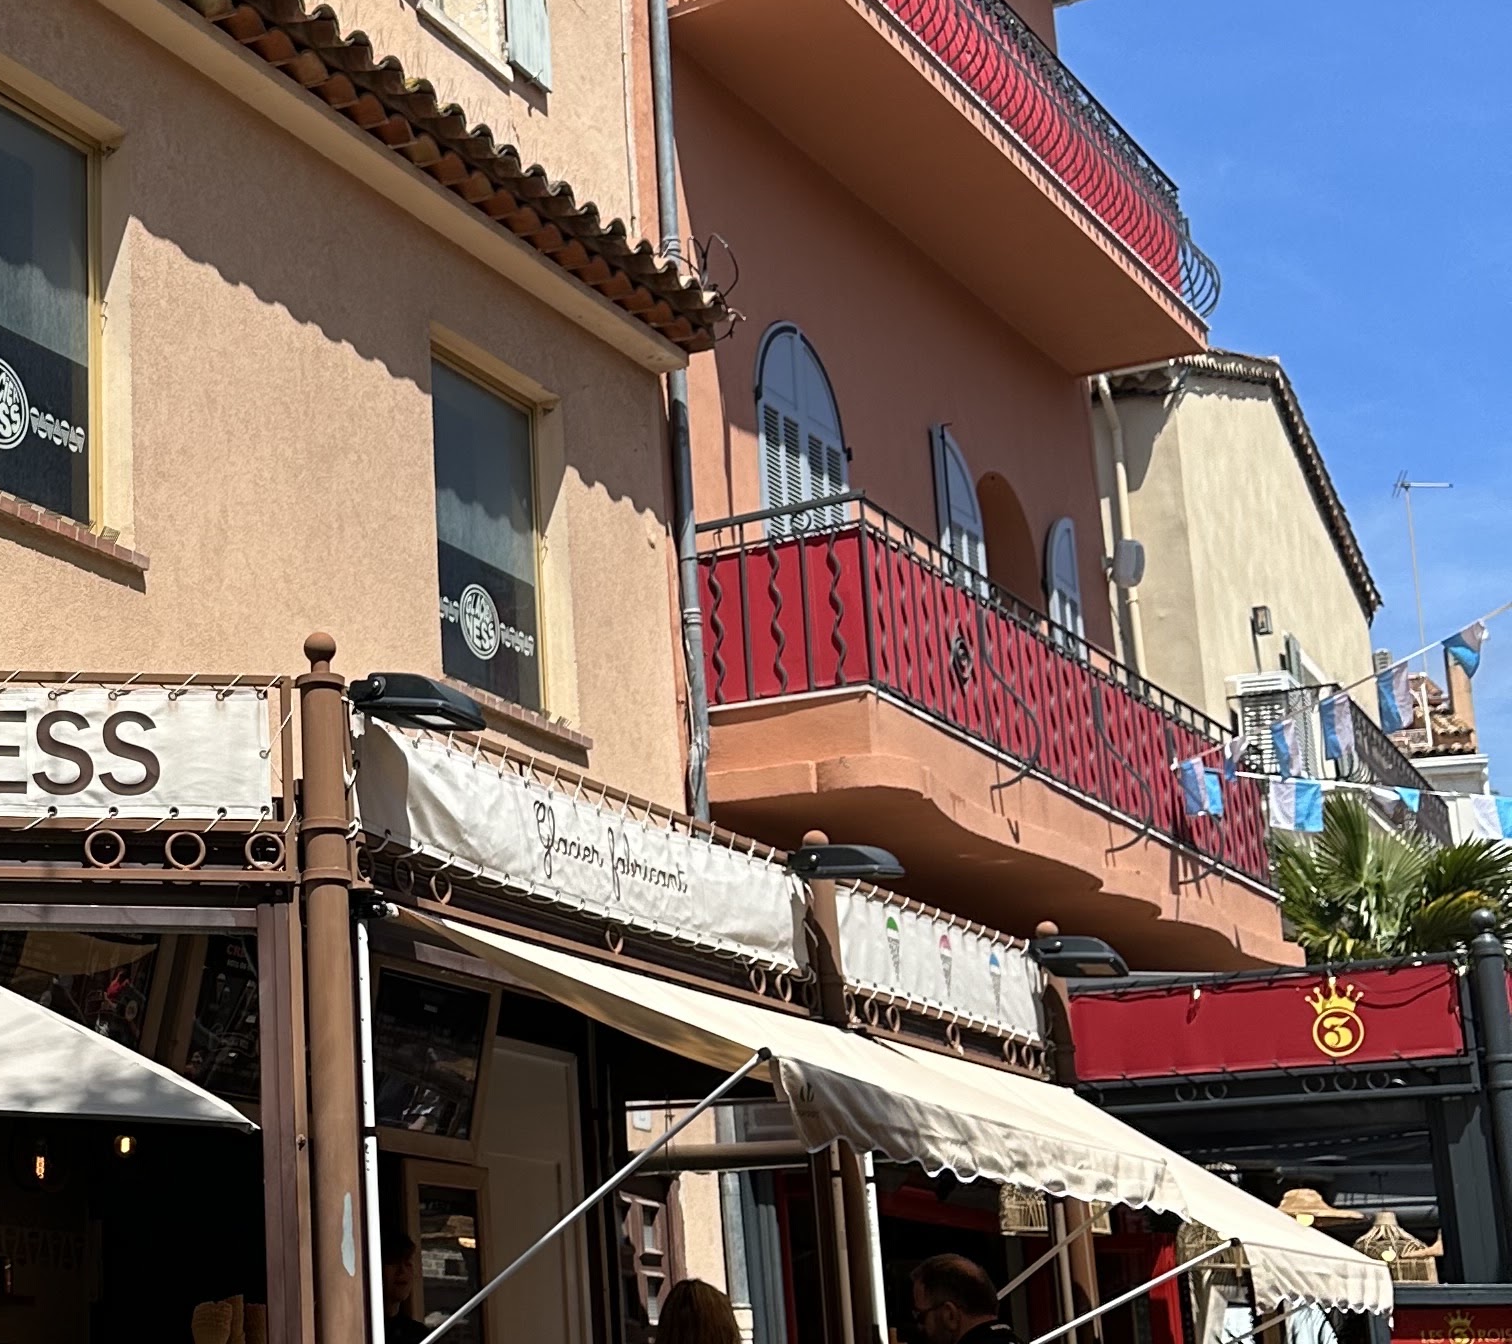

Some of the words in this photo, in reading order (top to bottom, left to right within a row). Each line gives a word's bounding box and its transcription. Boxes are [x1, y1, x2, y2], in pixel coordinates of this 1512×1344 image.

[466, 614, 495, 650] NESS
[534, 800, 604, 879] Glacier
[1322, 1015, 1353, 1048] 3
[1421, 1330, 1444, 1344] LES
